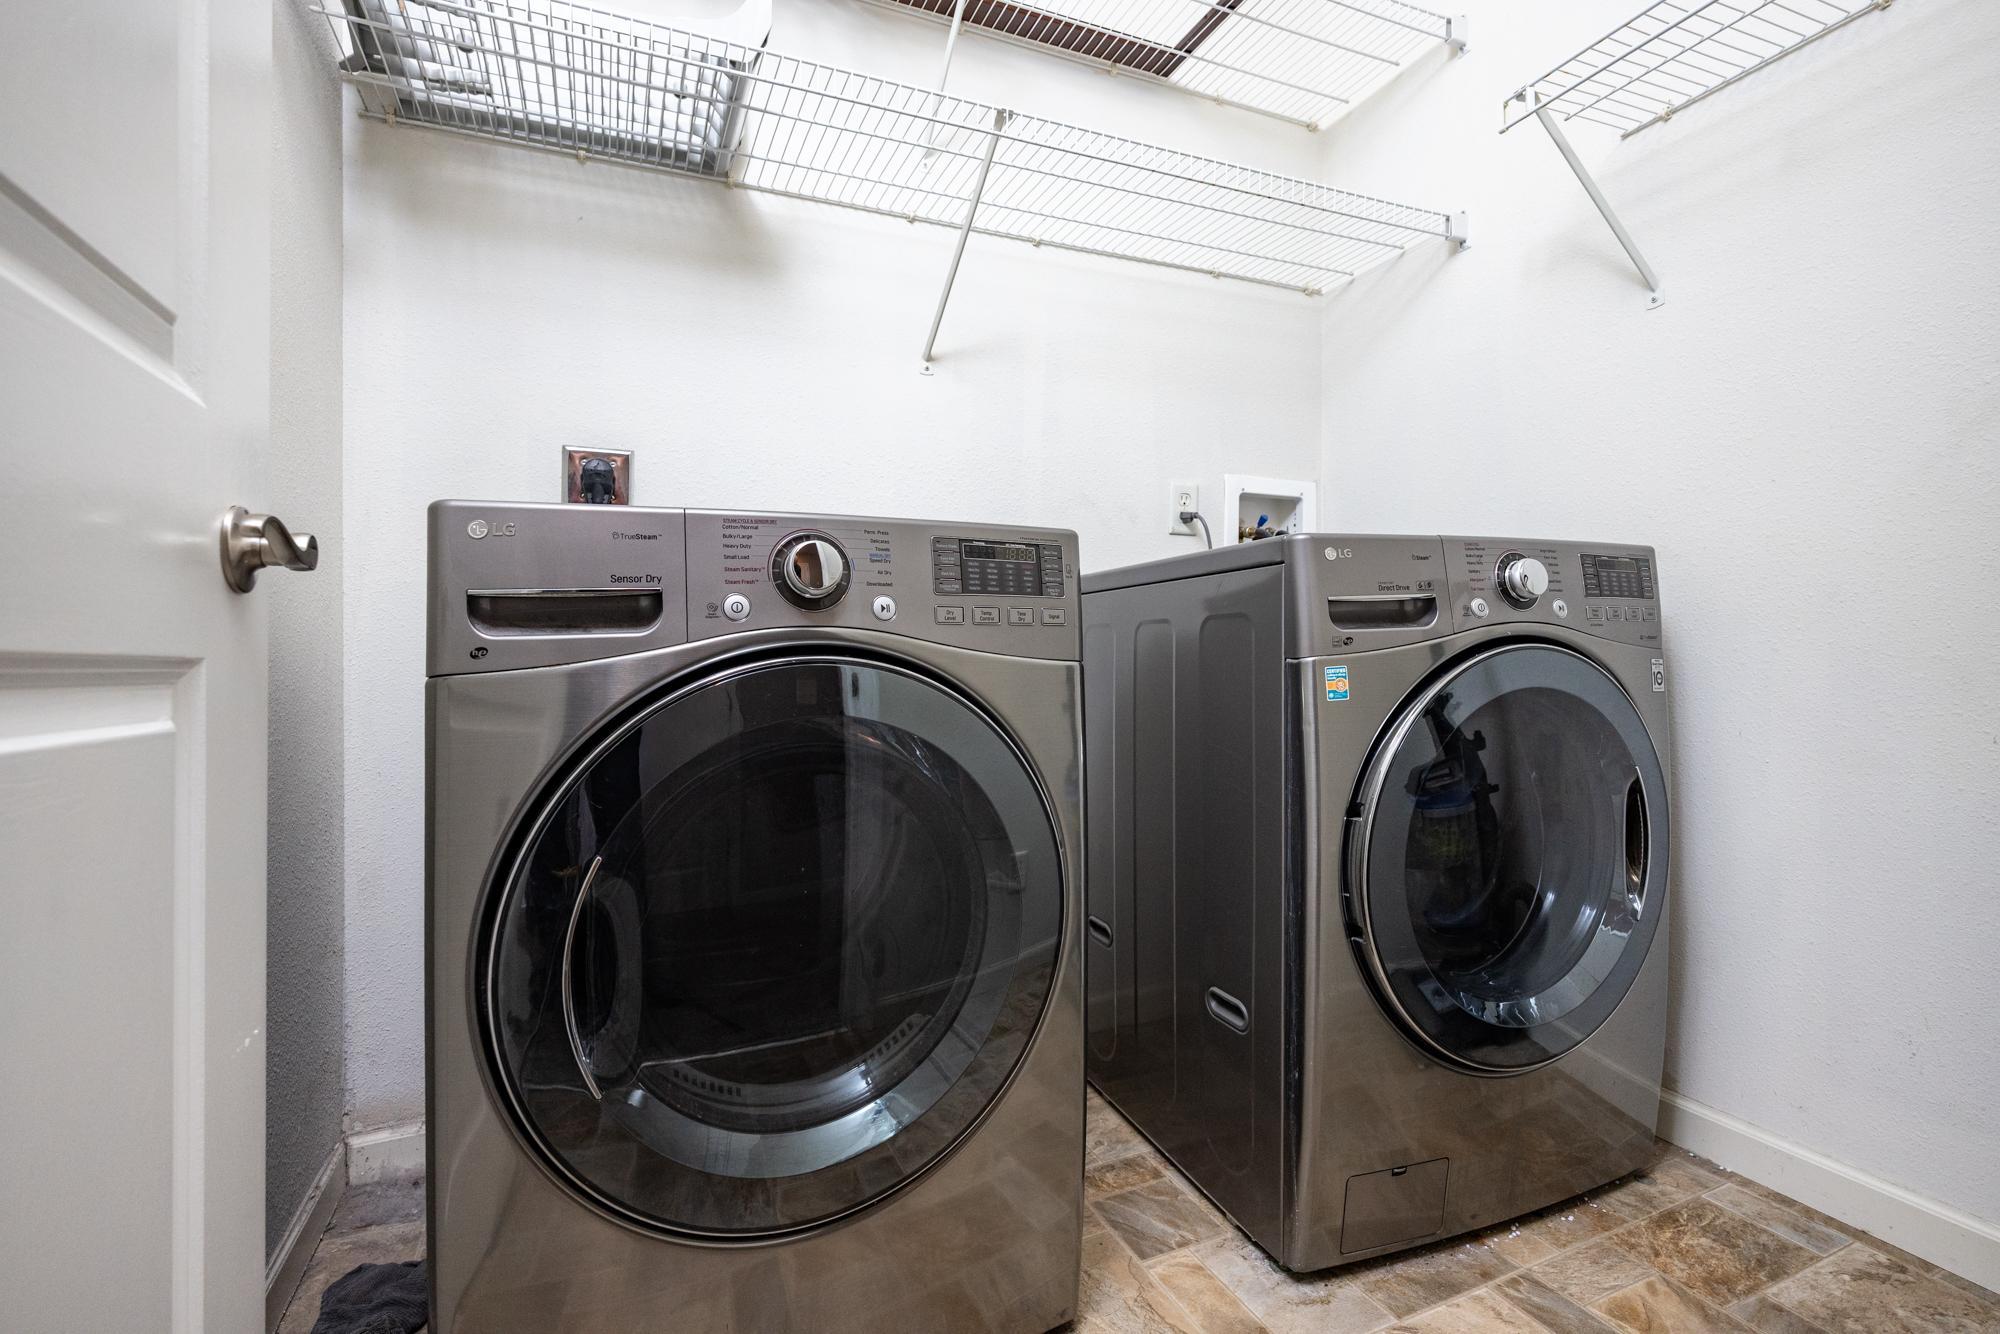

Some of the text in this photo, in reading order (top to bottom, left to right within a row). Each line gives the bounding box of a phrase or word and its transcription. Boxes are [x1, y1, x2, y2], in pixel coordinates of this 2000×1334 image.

[492, 522, 516, 537] LG
[1338, 549, 1352, 558] LG
[610, 574, 662, 587] Sensor Dry
[1378, 584, 1395, 592] Direct
